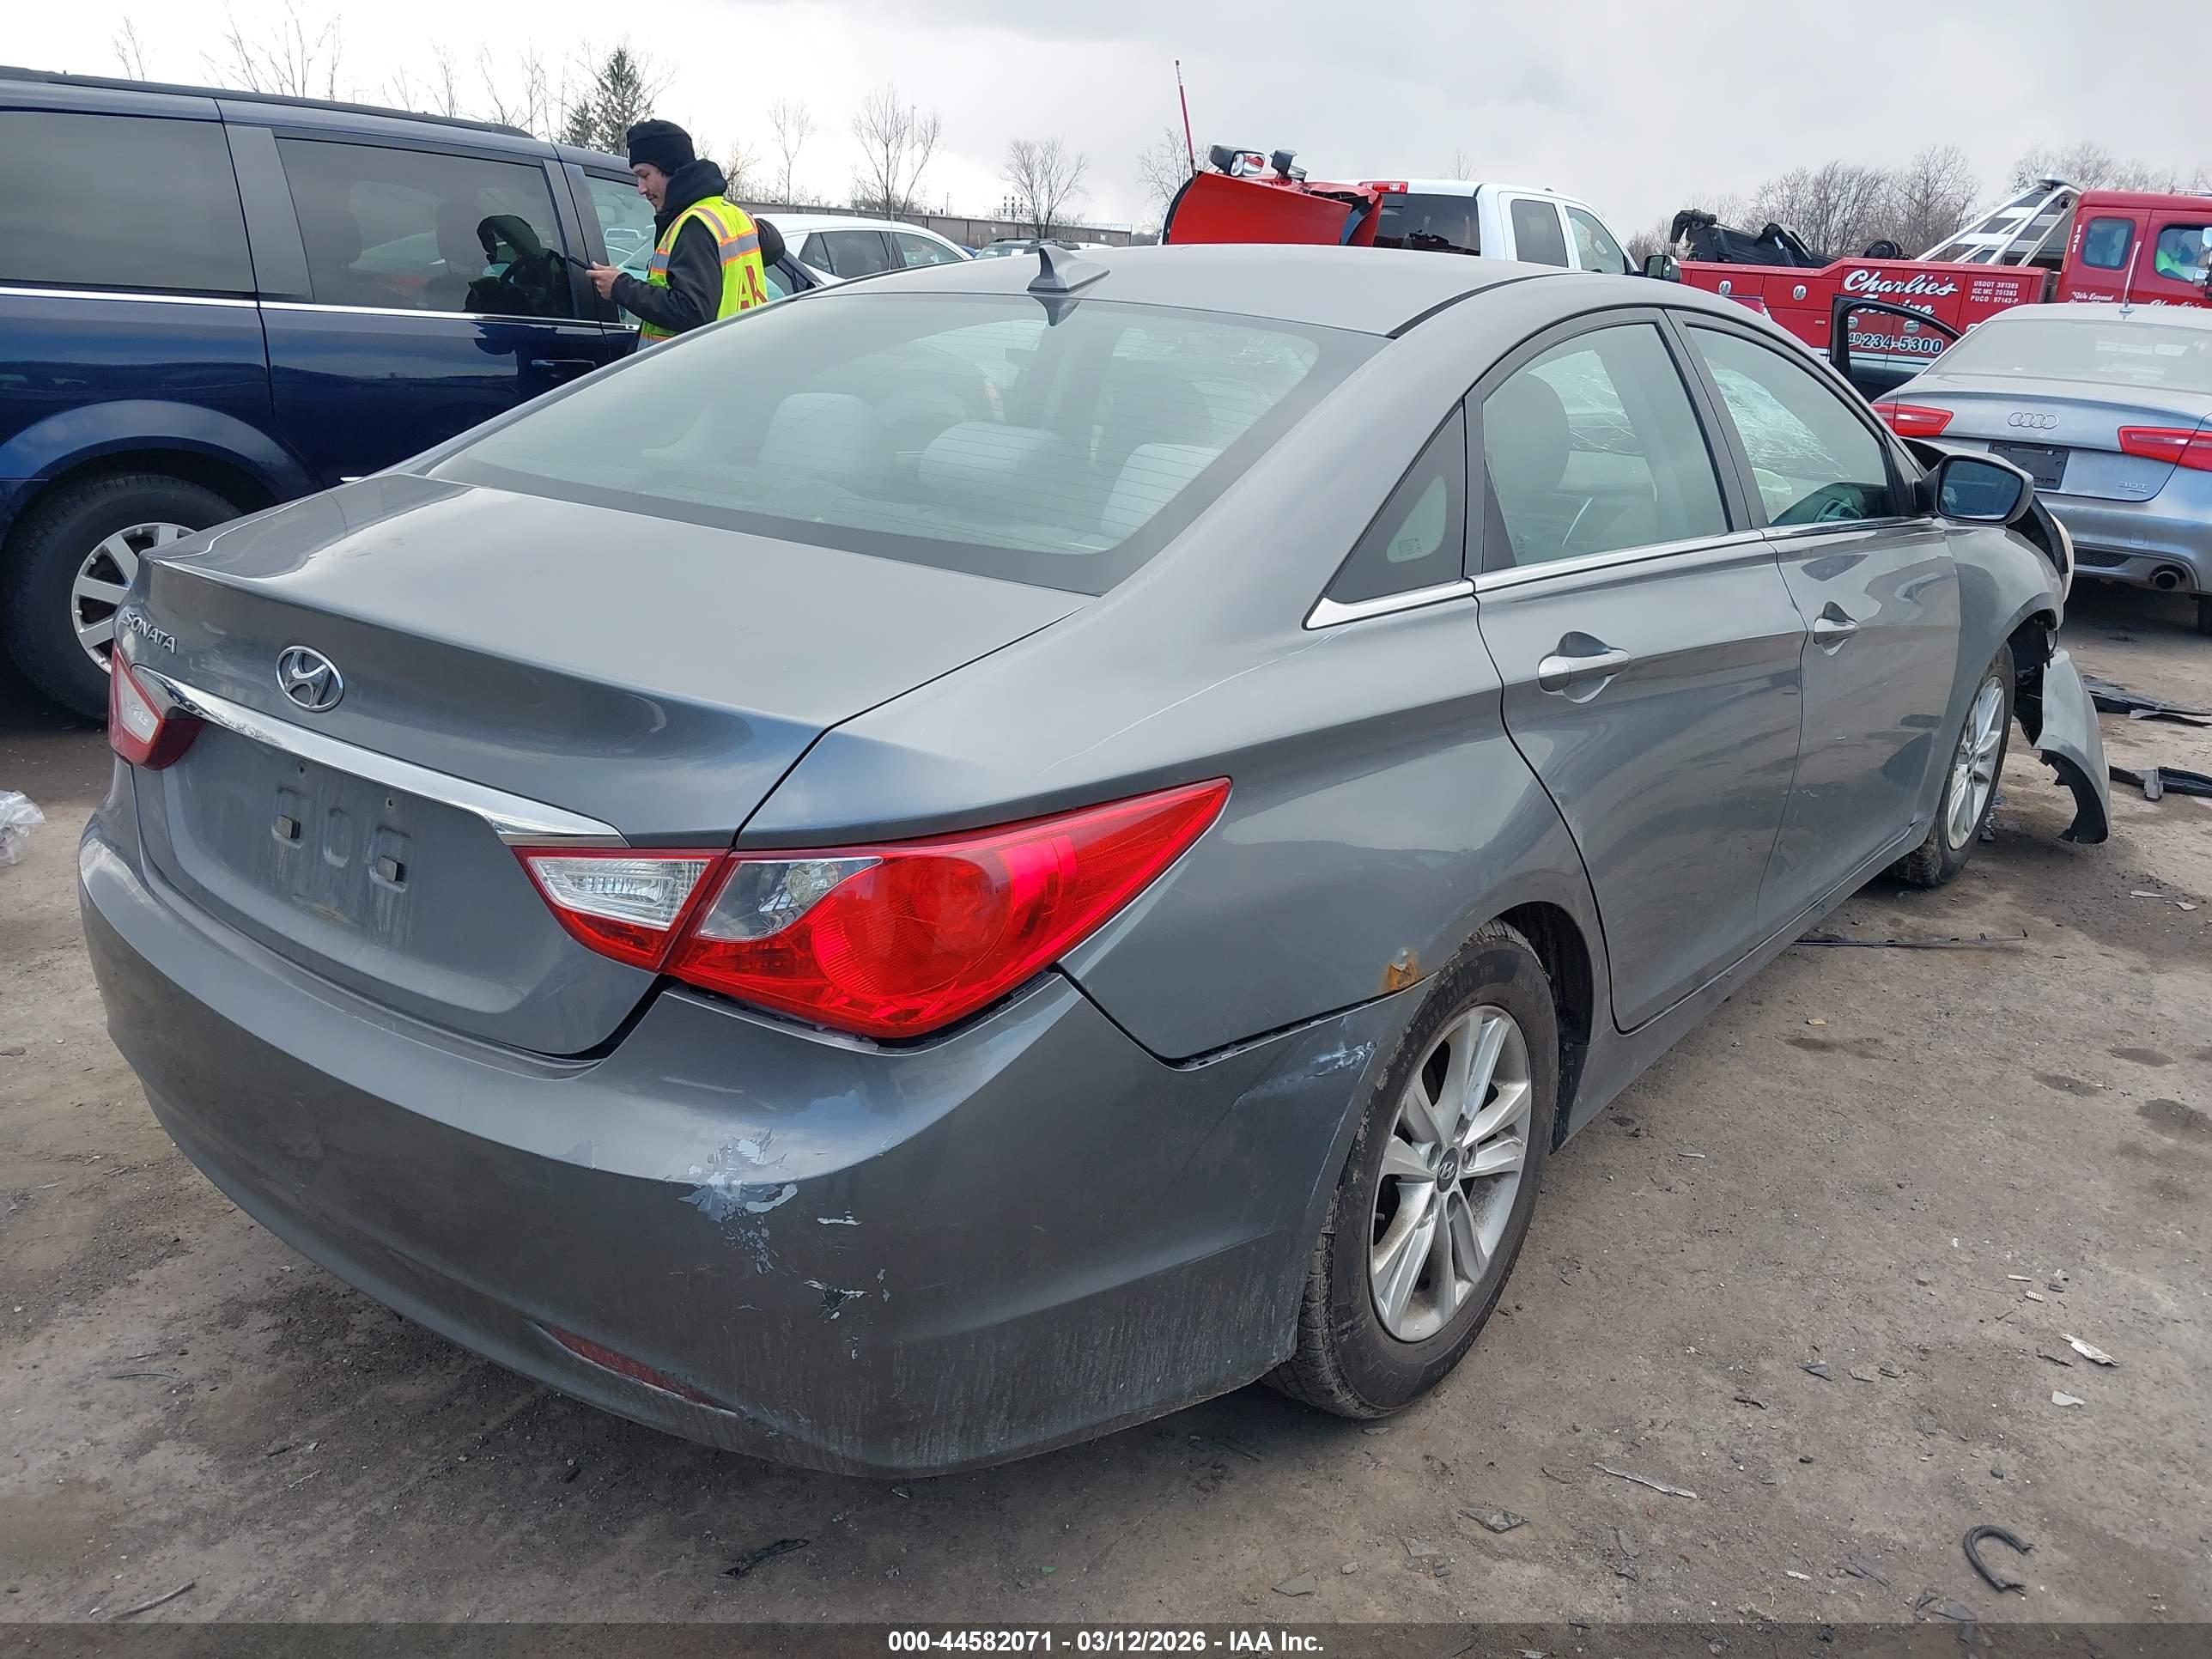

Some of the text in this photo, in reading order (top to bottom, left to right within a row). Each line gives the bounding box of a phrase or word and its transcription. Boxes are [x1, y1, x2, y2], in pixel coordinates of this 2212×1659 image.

[1844, 269, 1959, 296] Charlie's
[1973, 280, 1995, 289] USDOT
[1970, 295, 1990, 303] PUCO
[1861, 333, 1943, 354] 234-5300
[123, 612, 177, 653] SONATA
